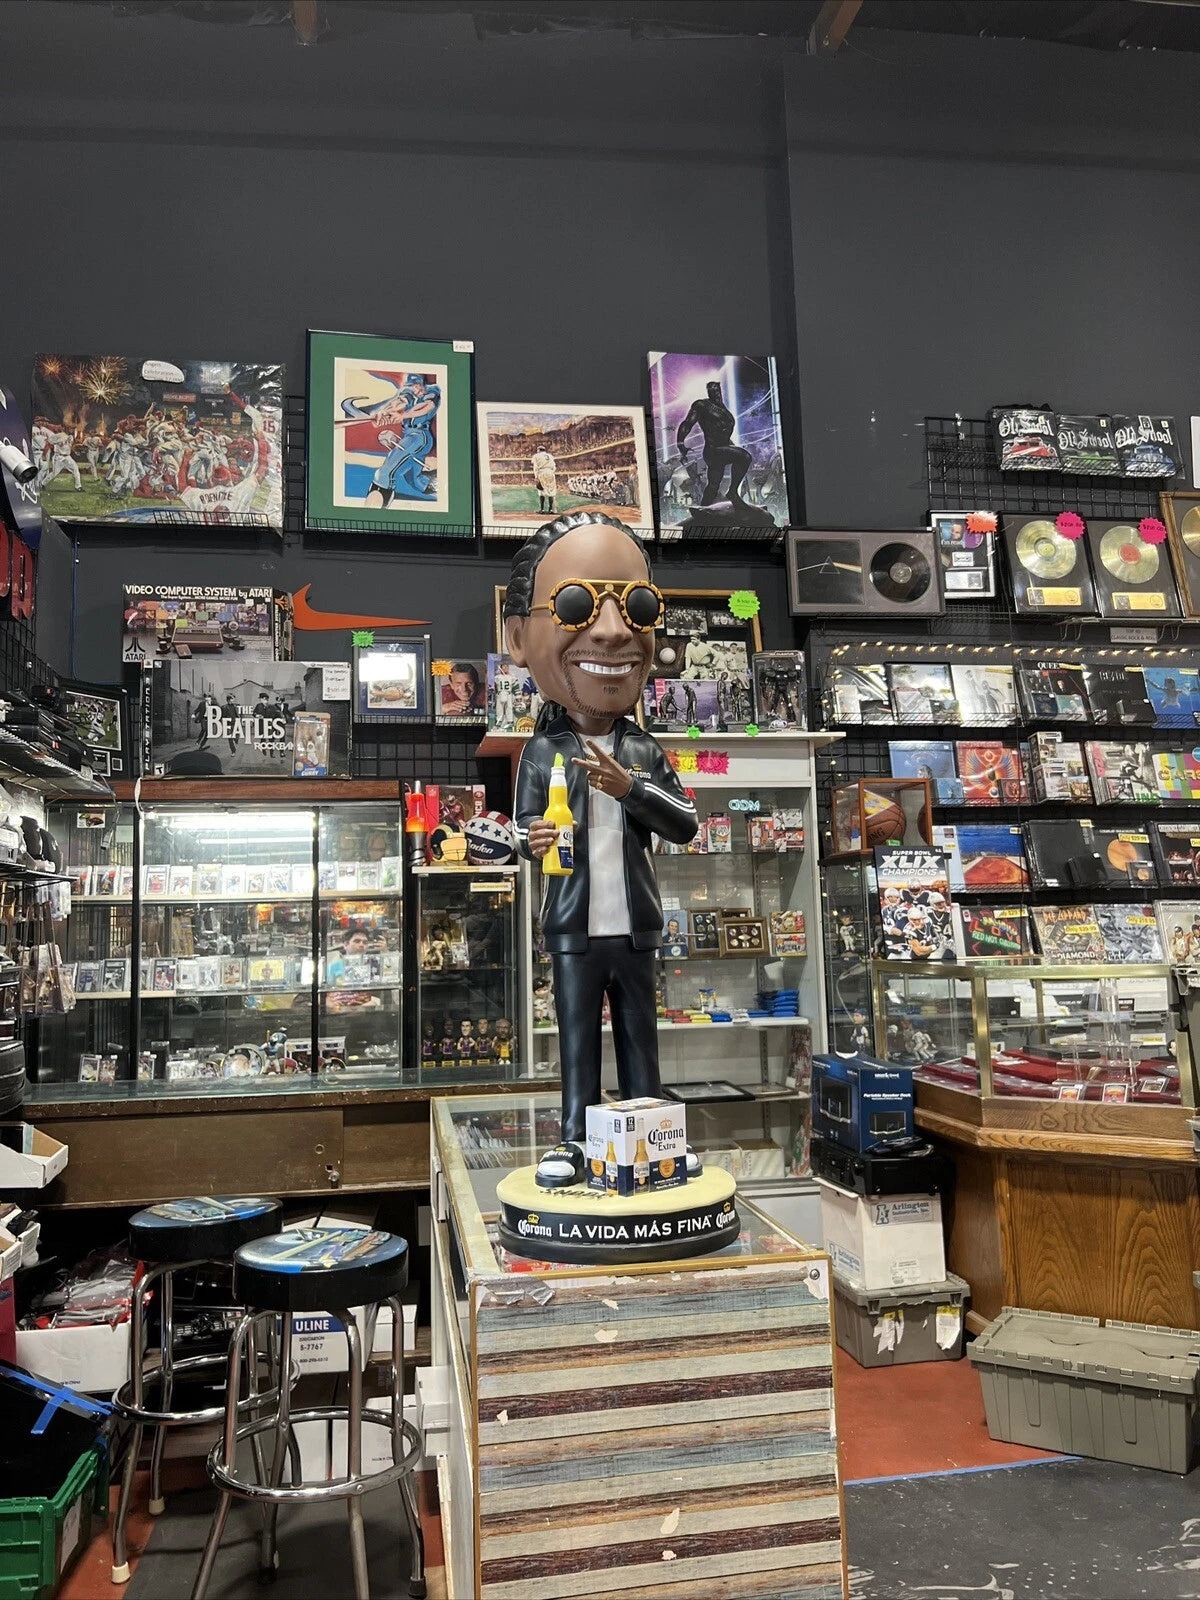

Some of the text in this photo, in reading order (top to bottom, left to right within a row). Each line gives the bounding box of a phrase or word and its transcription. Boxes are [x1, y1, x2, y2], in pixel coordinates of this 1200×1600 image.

[125, 585, 272, 599] VIDEO COMPUTER SYSTEM by ATARI
[499, 680, 510, 690] 12
[236, 705, 254, 715] THE
[206, 705, 287, 745] BEATLES
[879, 855, 941, 869] XLIX
[882, 868, 938, 876] CHAMPIONS
[627, 1117, 634, 1125] 12
[648, 1128, 684, 1145] Corona
[657, 1142, 676, 1151] Extra
[892, 1202, 929, 1211] Arlington
[517, 1219, 552, 1237] Corona
[559, 1223, 582, 1238] LA
[585, 1225, 629, 1239] VIDA
[634, 1220, 672, 1238] MÁS
[295, 1319, 329, 1332] ULINE
